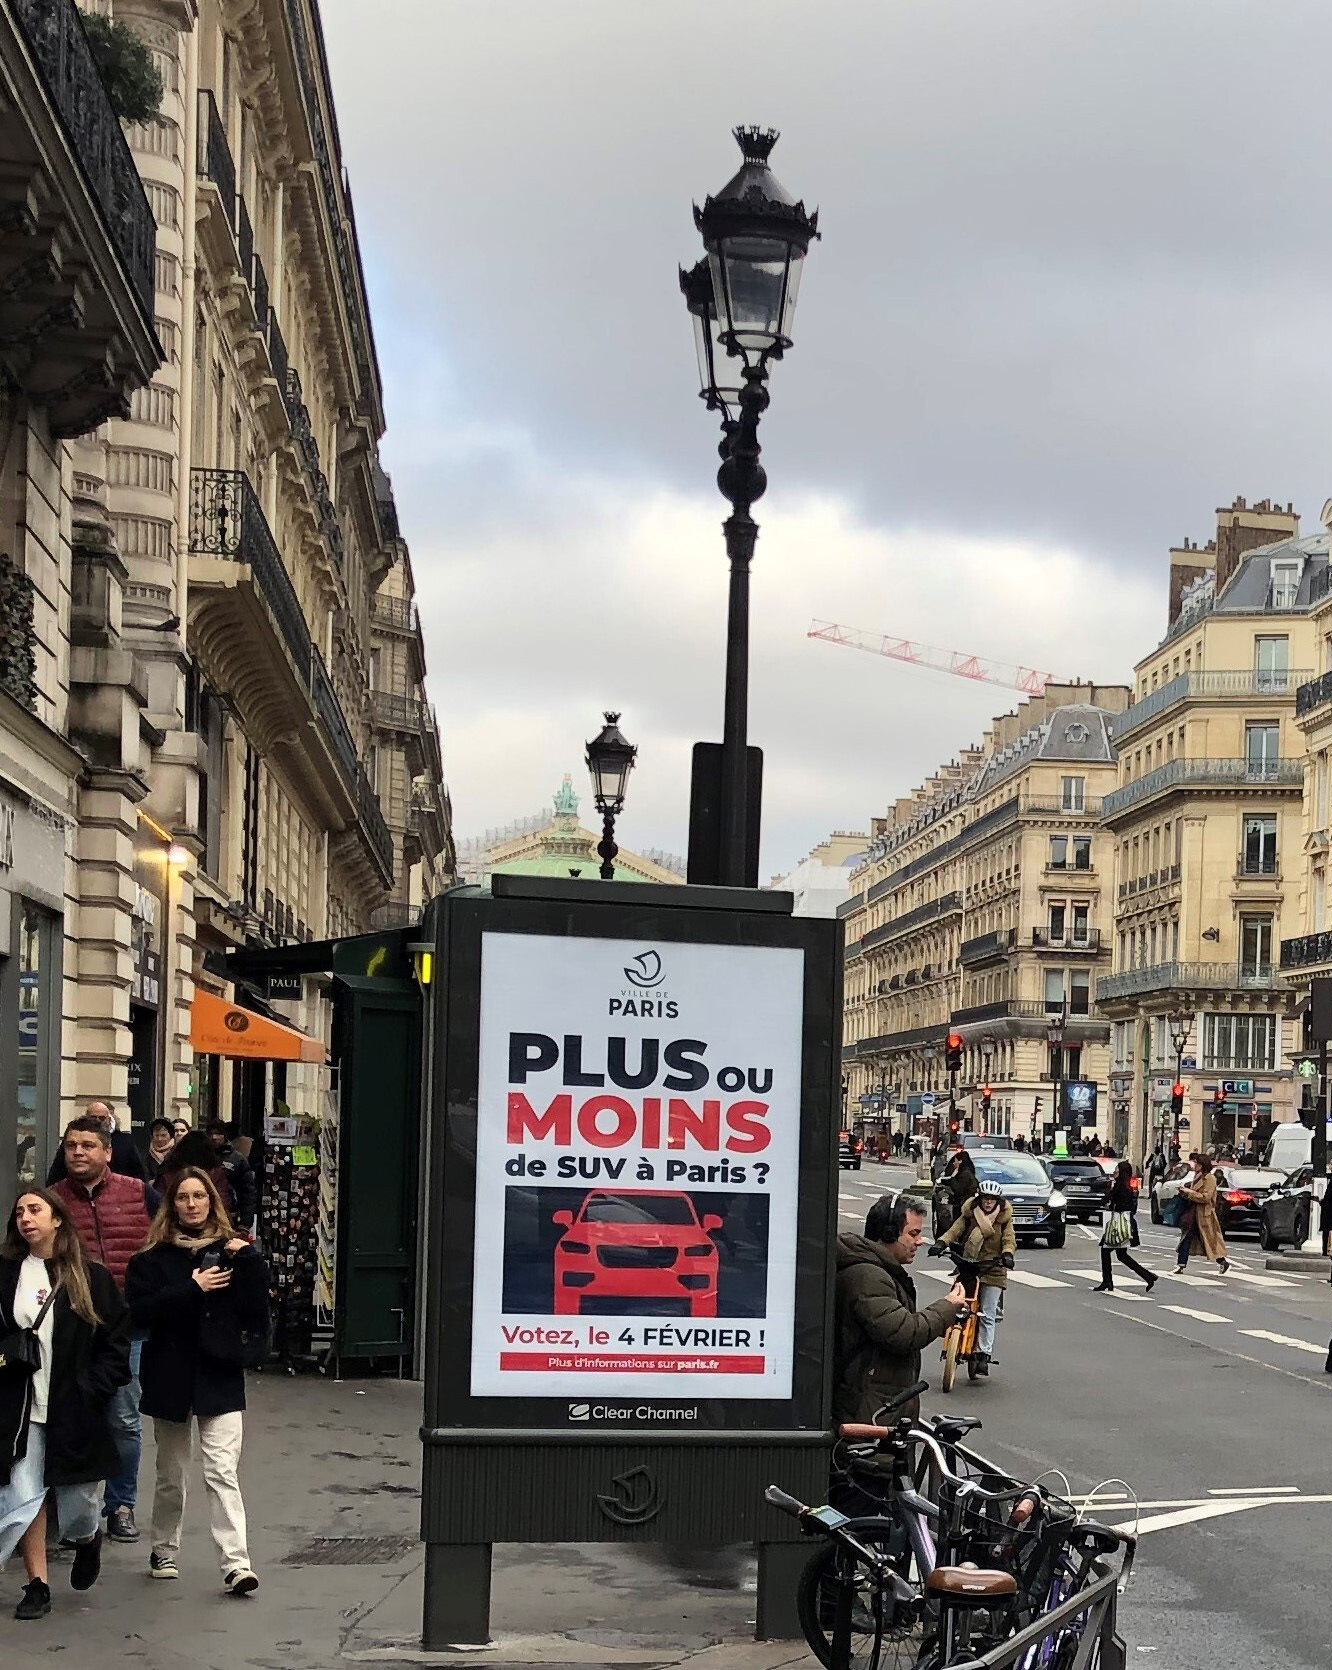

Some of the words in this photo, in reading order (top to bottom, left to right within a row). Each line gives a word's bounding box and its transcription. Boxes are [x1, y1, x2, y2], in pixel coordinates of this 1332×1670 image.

[271, 978, 300, 988] PAUL
[620, 990, 650, 998] VILLE
[609, 998, 679, 1019] PARIS
[508, 1032, 710, 1092] PLUS
[716, 1066, 773, 1094] OU
[1224, 1082, 1248, 1093] CIC
[507, 1092, 771, 1154] MOINS
[505, 1154, 547, 1177] de
[557, 1156, 627, 1180] SUV
[635, 1157, 654, 1180] à
[501, 1326, 580, 1348] Votez,
[589, 1326, 610, 1345] le
[618, 1327, 634, 1346] 4
[644, 1324, 750, 1348] FÉVRIER
[759, 1330, 765, 1348] !
[548, 1358, 572, 1368] Plus
[574, 1357, 655, 1370] d'informations
[657, 1360, 676, 1370] sur
[677, 1359, 719, 1371] paris.fr
[592, 1406, 633, 1420] Clear
[636, 1407, 698, 1420] Channel
